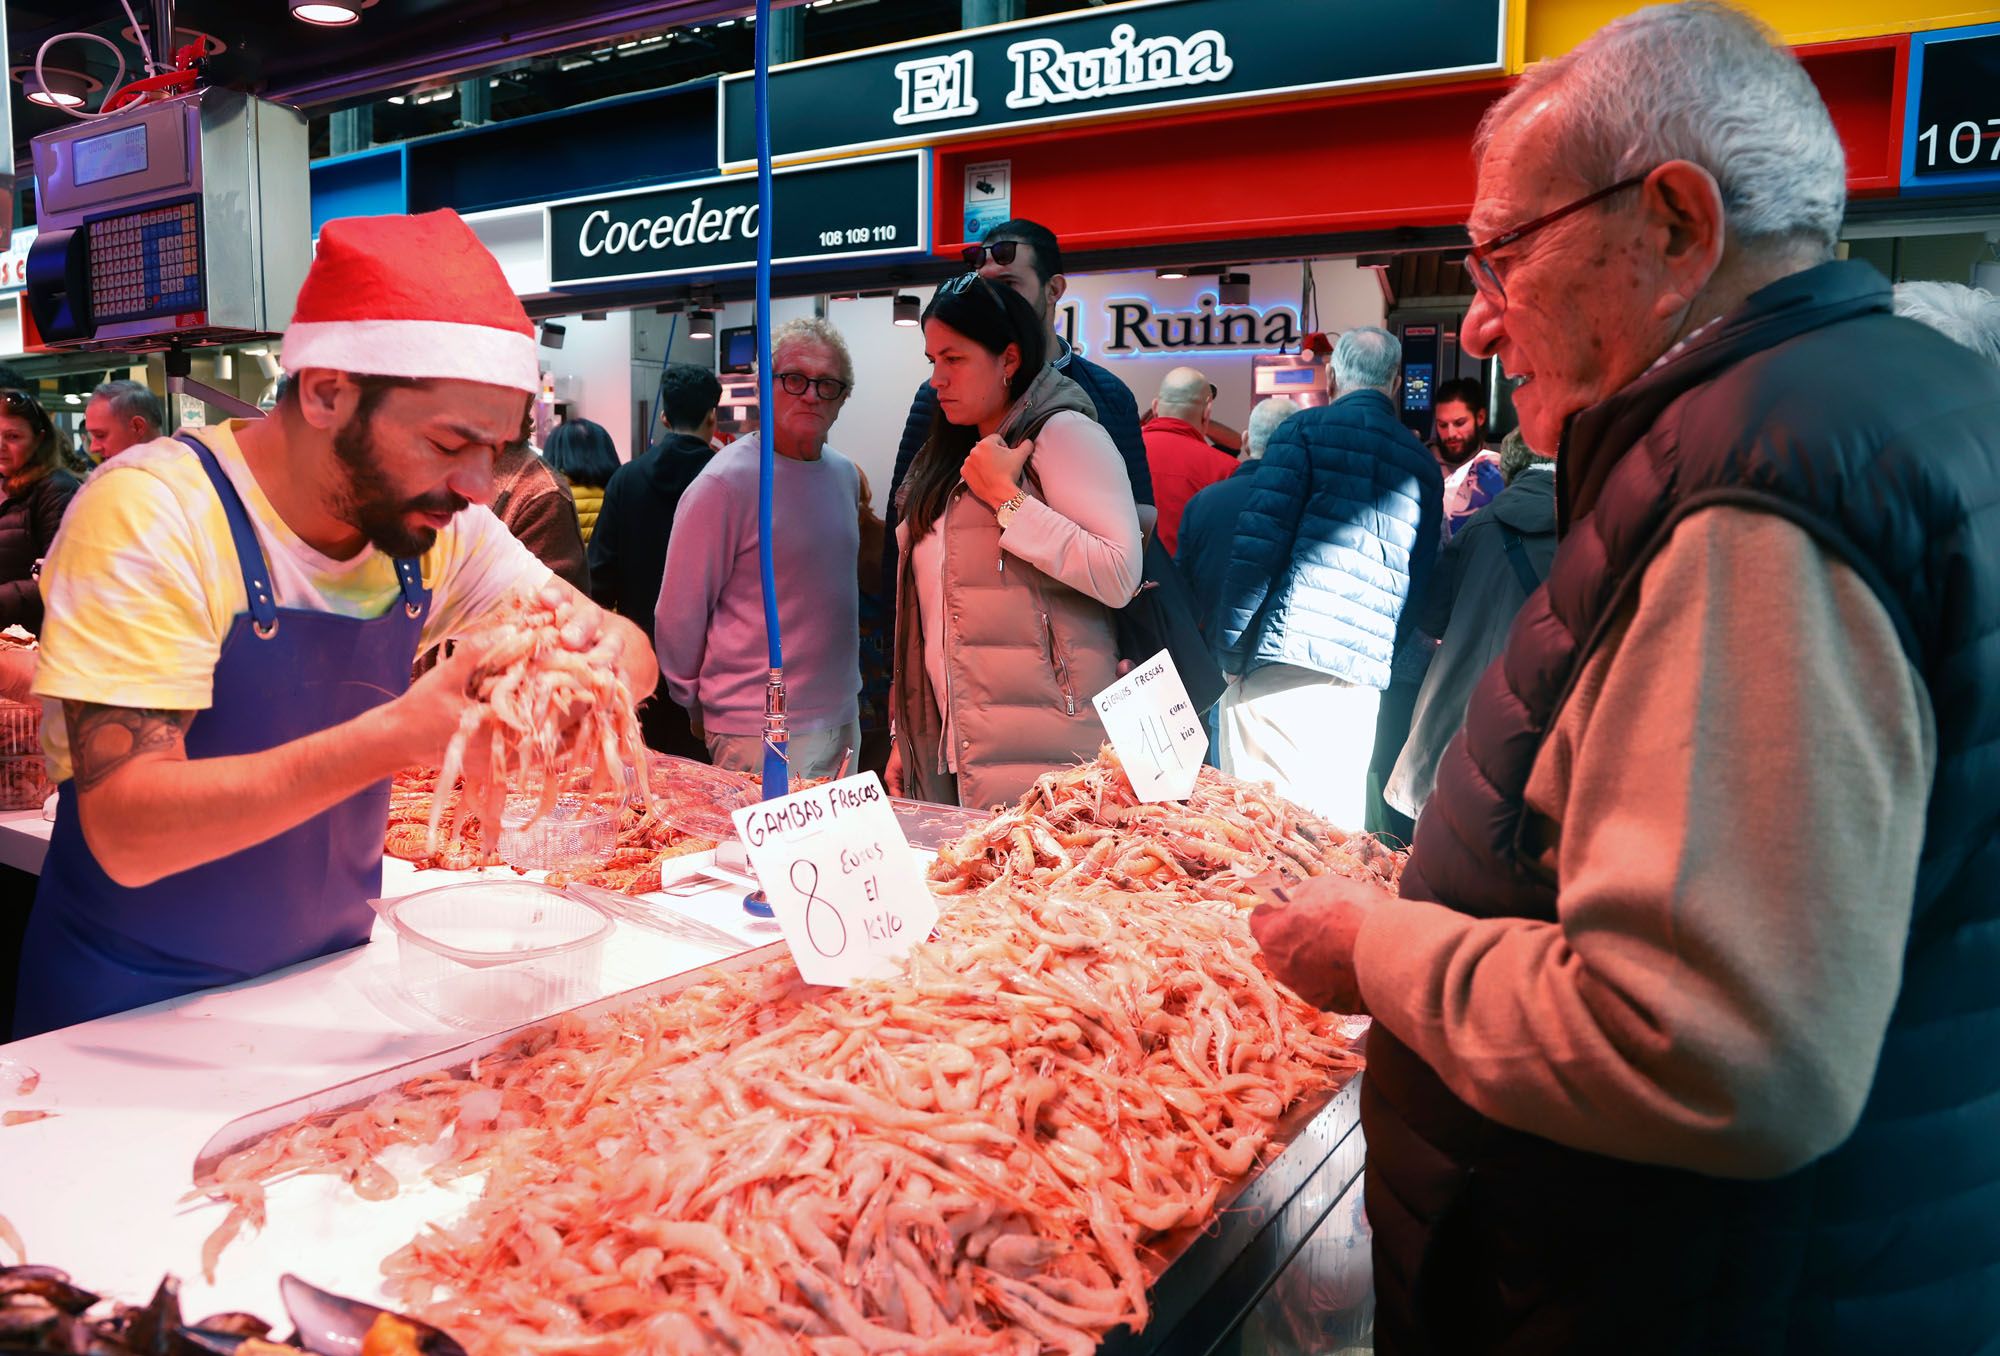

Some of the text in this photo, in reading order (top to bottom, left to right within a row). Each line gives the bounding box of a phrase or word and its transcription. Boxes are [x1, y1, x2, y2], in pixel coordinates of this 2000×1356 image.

[893, 23, 1234, 125] El Ruina
[578, 197, 759, 257] Cocedero
[818, 224, 896, 247] 108 109 110
[1106, 296, 1302, 351] Ruina
[1134, 663, 1165, 688] FRESCAS
[1138, 715, 1184, 780] 14
[746, 783, 880, 847] GAMBAS FRESCAS
[789, 859, 847, 958] 8
